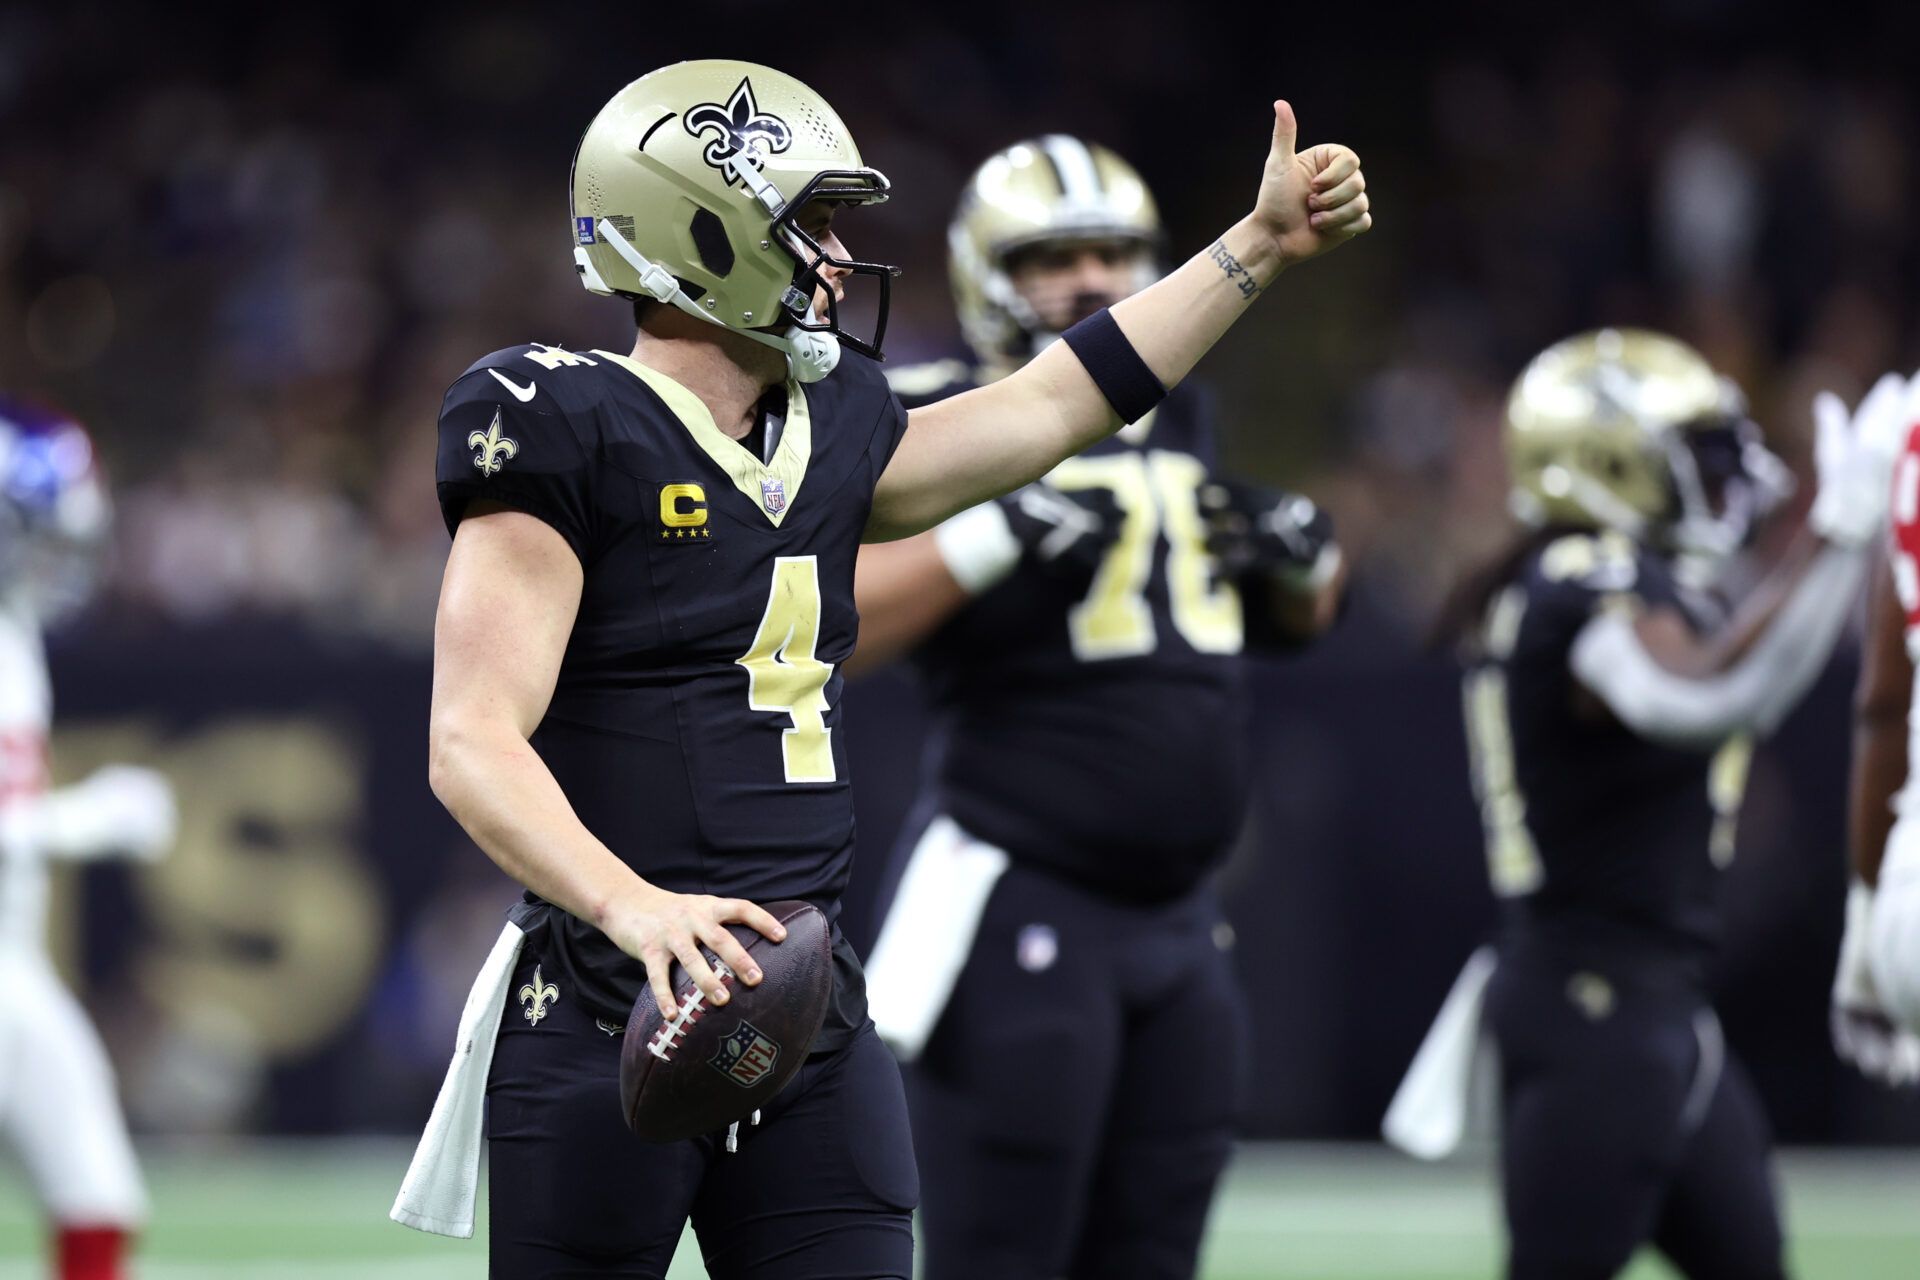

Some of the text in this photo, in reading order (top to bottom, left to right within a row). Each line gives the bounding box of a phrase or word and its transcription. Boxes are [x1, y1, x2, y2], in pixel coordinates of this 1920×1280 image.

[660, 483, 709, 527] C
[767, 494, 785, 509] NFL
[736, 554, 835, 783] 4
[732, 1043, 777, 1082] NFL
